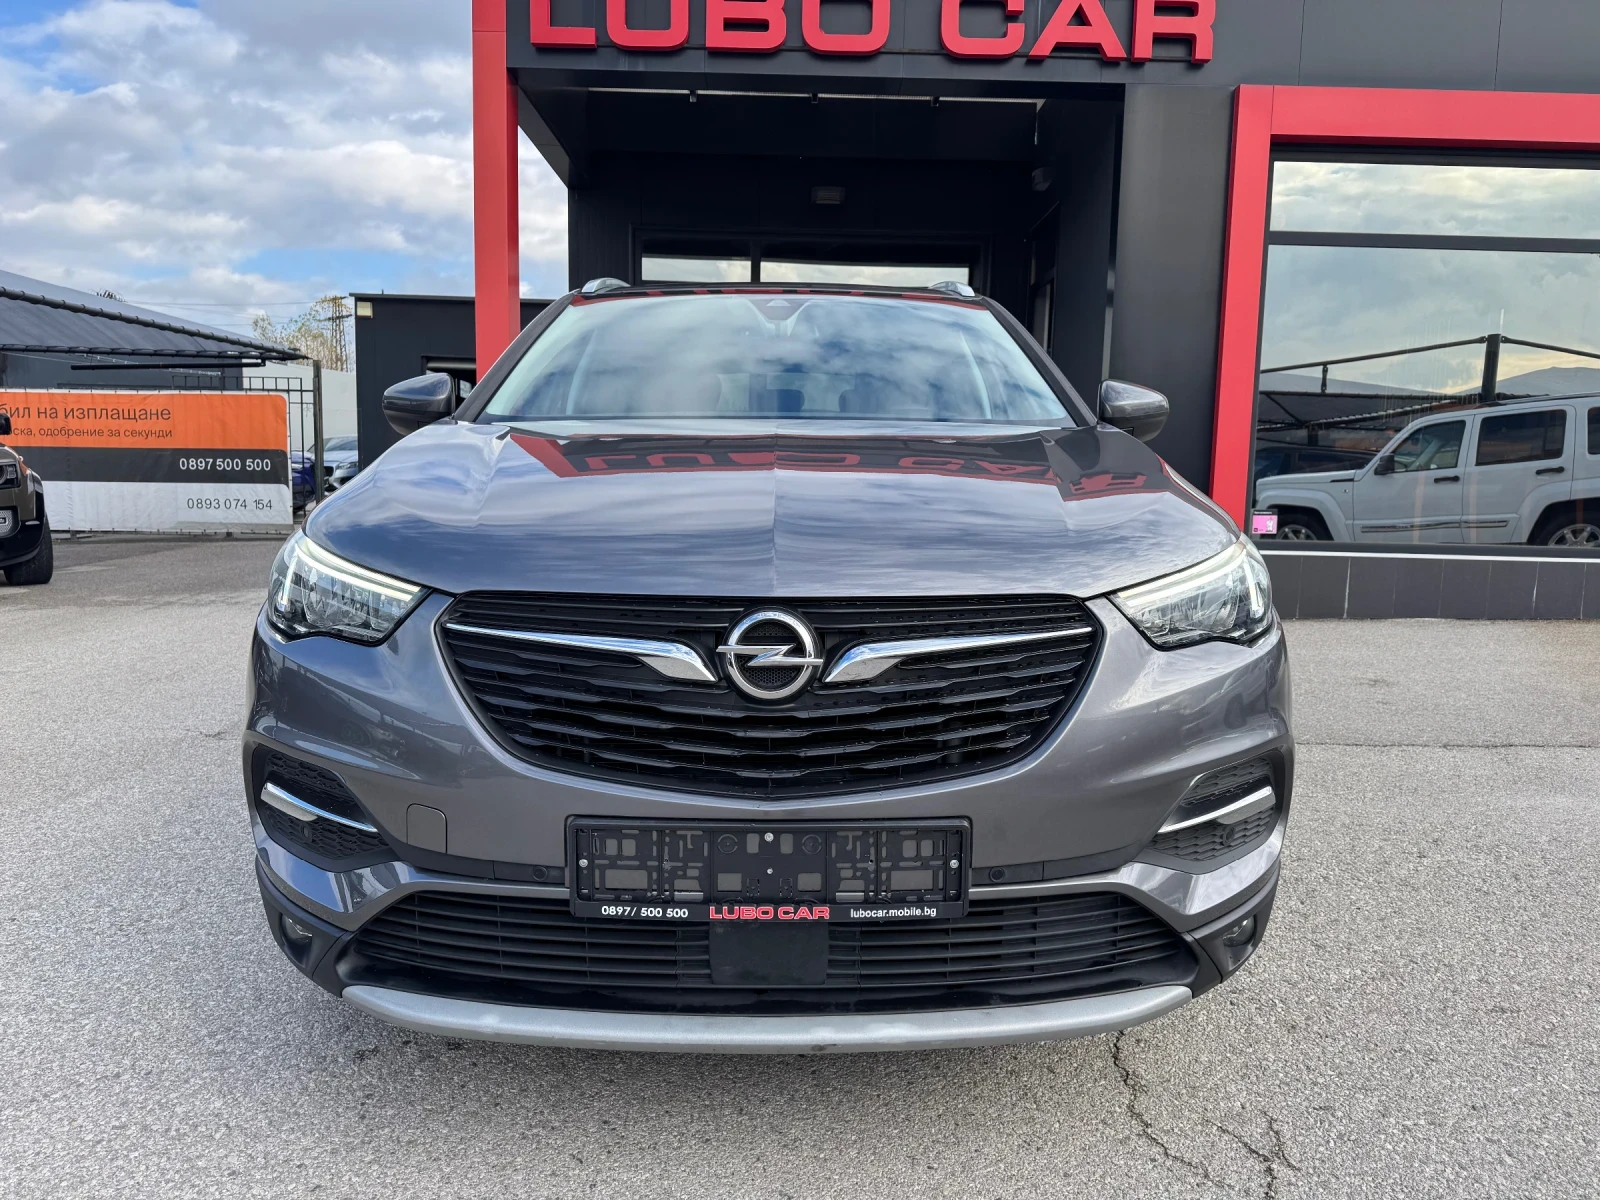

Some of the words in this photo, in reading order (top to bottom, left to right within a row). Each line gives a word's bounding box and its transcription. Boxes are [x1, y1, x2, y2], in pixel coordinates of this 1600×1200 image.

[529, 0, 891, 55] LUBO
[940, 0, 1216, 63] CAR
[37, 407, 58, 419] на
[64, 407, 171, 422] изплащане
[11, 427, 36, 437] ска,
[38, 427, 105, 438] одобрение
[107, 429, 121, 438] за
[123, 429, 173, 439] секунди
[179, 457, 213, 470] 0897
[216, 458, 241, 471] 500
[245, 458, 271, 471] 500
[186, 497, 221, 510] 0893
[224, 498, 248, 510] 074
[252, 499, 273, 510] 154
[601, 905, 637, 916] 0897/
[640, 907, 663, 918] 500
[665, 908, 689, 918] 500
[709, 906, 774, 920] LUBO
[777, 906, 830, 920] CAR
[850, 906, 937, 919] lubocar.mobile.bg
